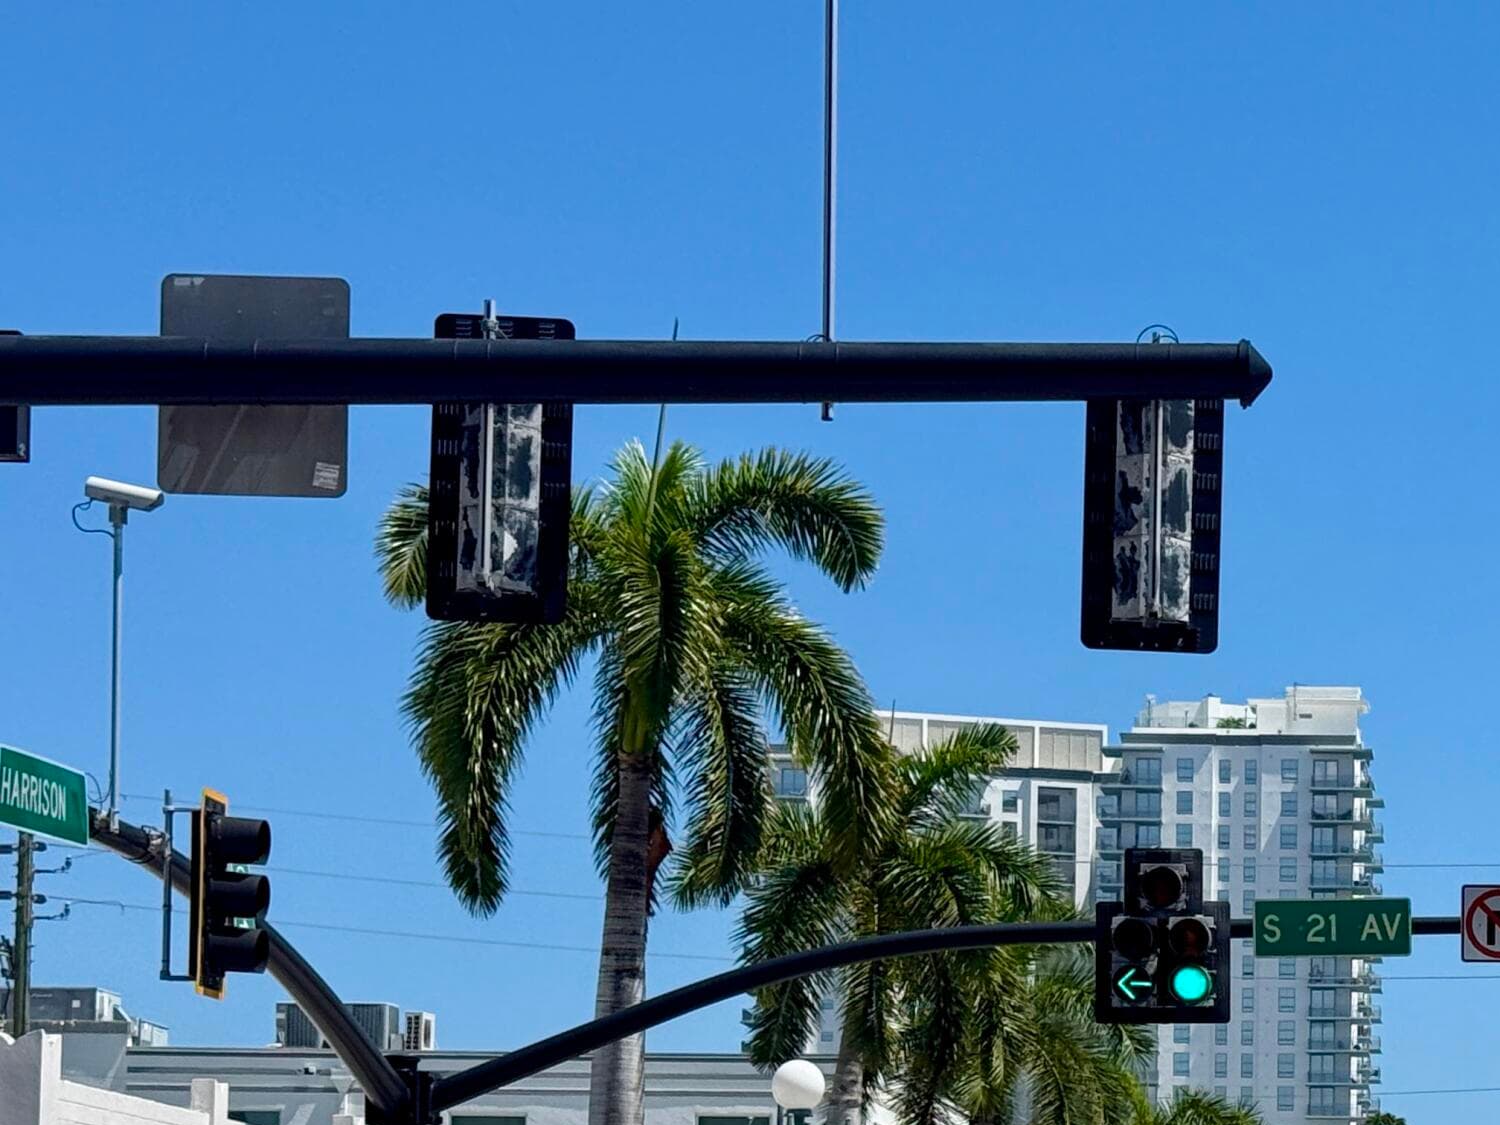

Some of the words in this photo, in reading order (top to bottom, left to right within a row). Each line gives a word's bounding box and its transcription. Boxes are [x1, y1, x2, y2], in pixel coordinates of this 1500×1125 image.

[0, 766, 67, 822] HARRISON
[1263, 914, 1281, 943] S
[1307, 914, 1337, 943] 21
[1360, 913, 1402, 941] AV
